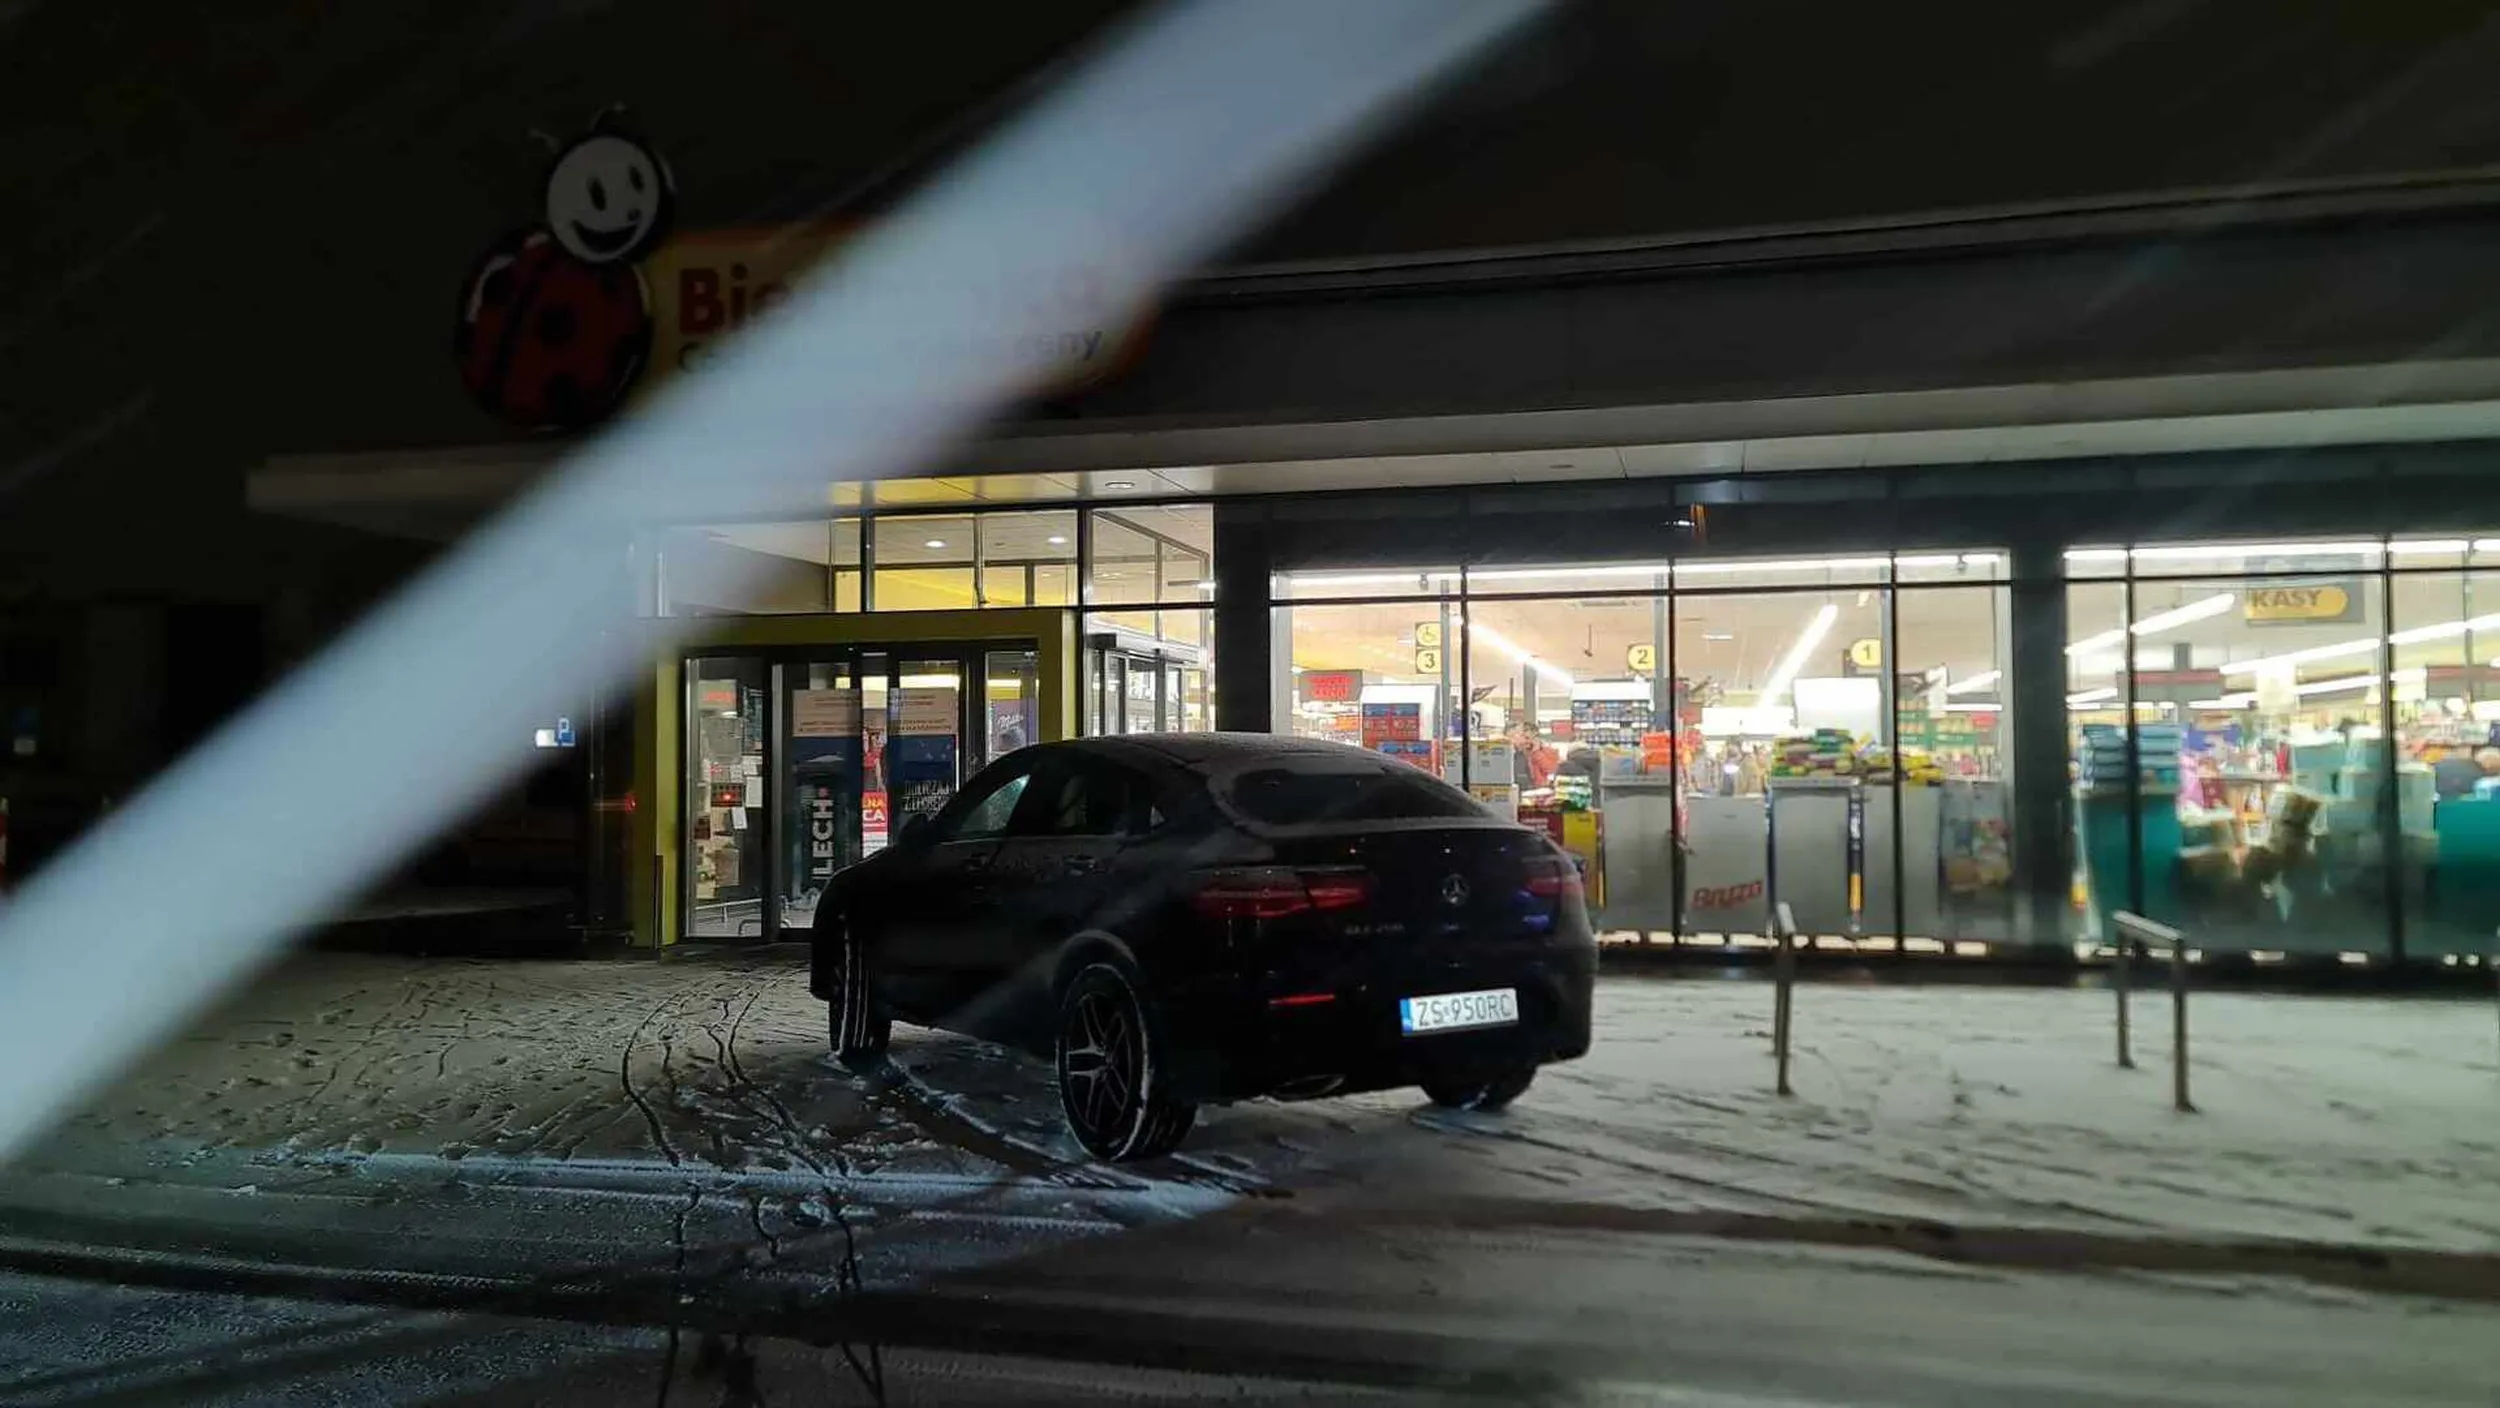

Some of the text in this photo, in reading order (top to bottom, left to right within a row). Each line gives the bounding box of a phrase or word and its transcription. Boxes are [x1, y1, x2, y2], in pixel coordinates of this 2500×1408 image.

[2252, 588, 2321, 608] KASY
[1424, 652, 1436, 669] 3
[1637, 649, 1649, 665] 2
[1863, 644, 1872, 660] 1
[1416, 992, 1514, 1027] ZS 950RC
